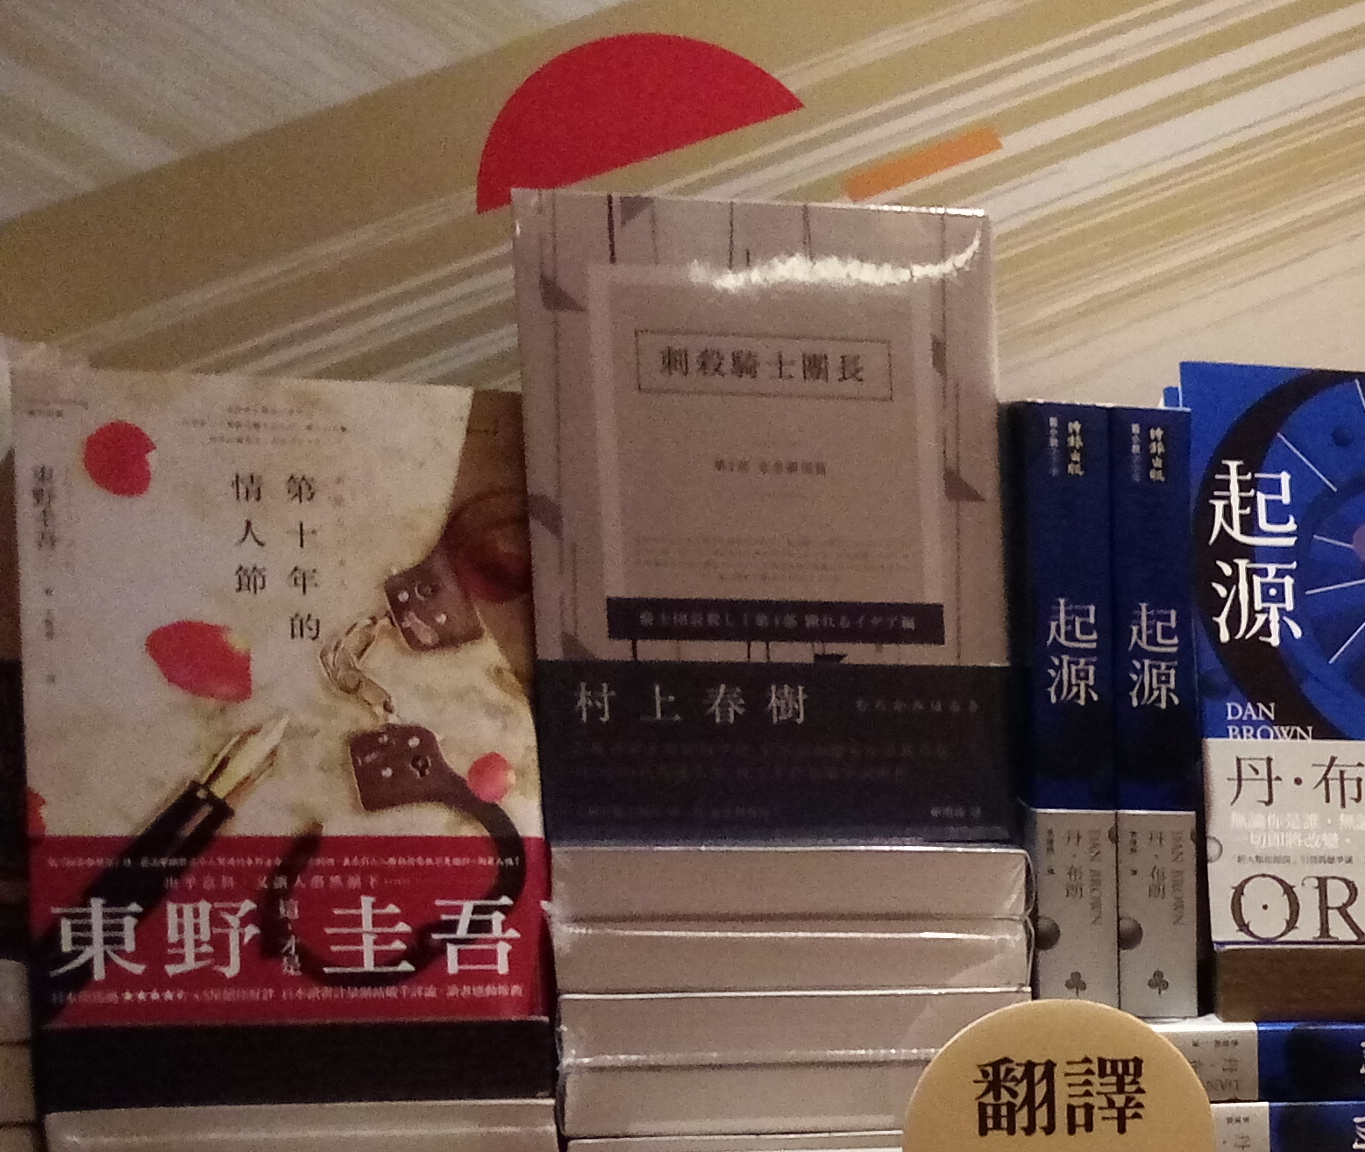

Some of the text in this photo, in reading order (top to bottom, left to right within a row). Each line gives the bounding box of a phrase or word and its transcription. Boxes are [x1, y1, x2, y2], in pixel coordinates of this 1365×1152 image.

[660, 344, 865, 385] 刺殺騎士團長
[233, 473, 267, 594] 情人節
[286, 474, 320, 641] 第十年的
[1208, 459, 1303, 648] 起源
[1046, 598, 1100, 707] 起源
[1128, 602, 1181, 710] 起源
[574, 683, 808, 724] 村上春樹
[1226, 703, 1276, 721] DAN
[1226, 726, 1314, 742] BROWN
[49, 896, 521, 980] 東野圭吾
[972, 1055, 1147, 1138] 翻譯
